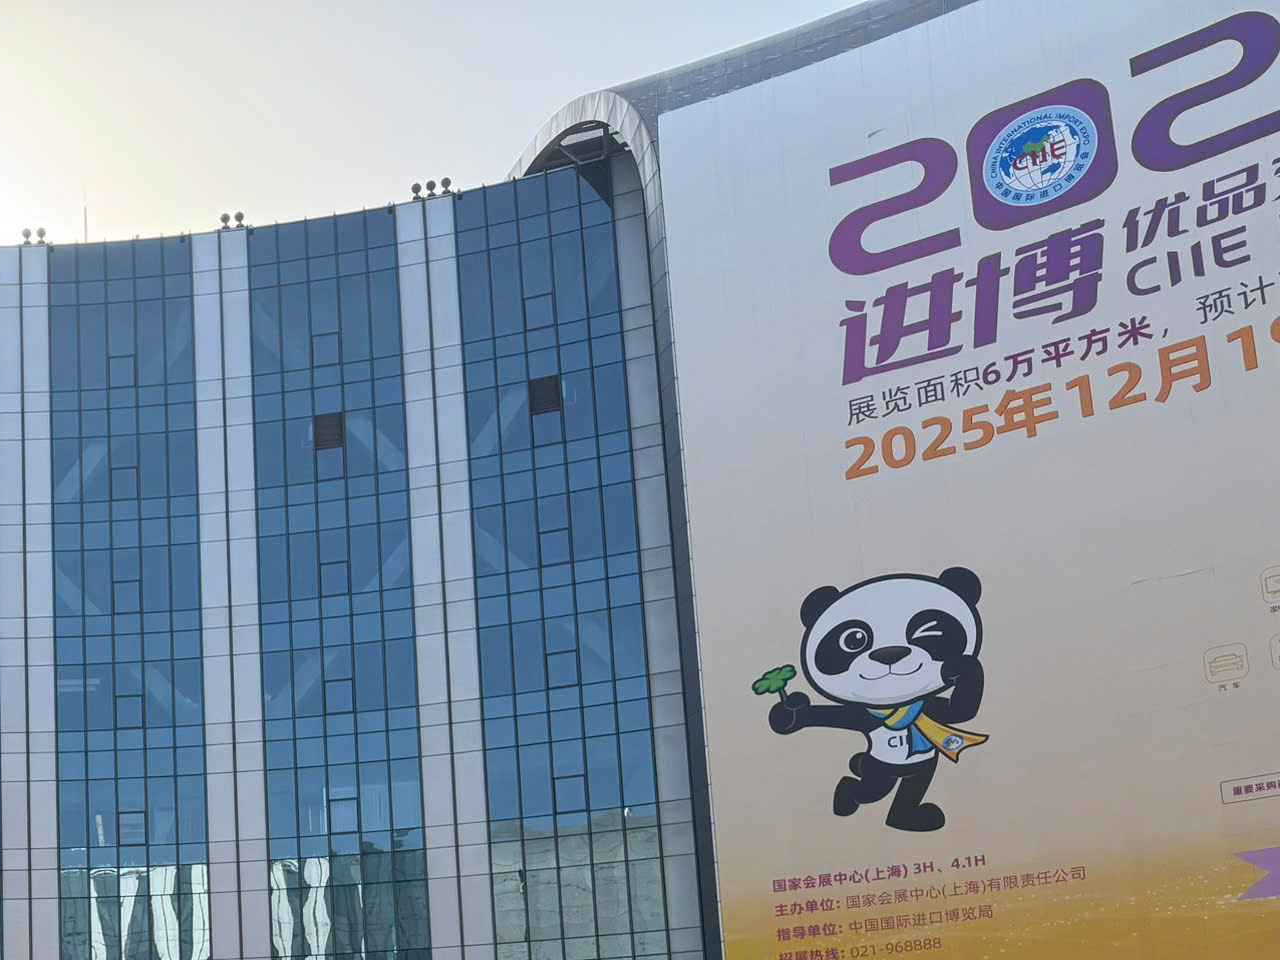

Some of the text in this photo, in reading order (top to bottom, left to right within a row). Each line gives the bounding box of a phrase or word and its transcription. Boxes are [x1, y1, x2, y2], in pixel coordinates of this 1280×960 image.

[990, 112, 1090, 179] CHINA INTERNATIONAL IMPORT EXPO
[1122, 157, 1280, 253] 优品
[1126, 225, 1251, 296] CIIE
[839, 218, 1105, 386] 进博
[1232, 780, 1280, 796] 重要采购
